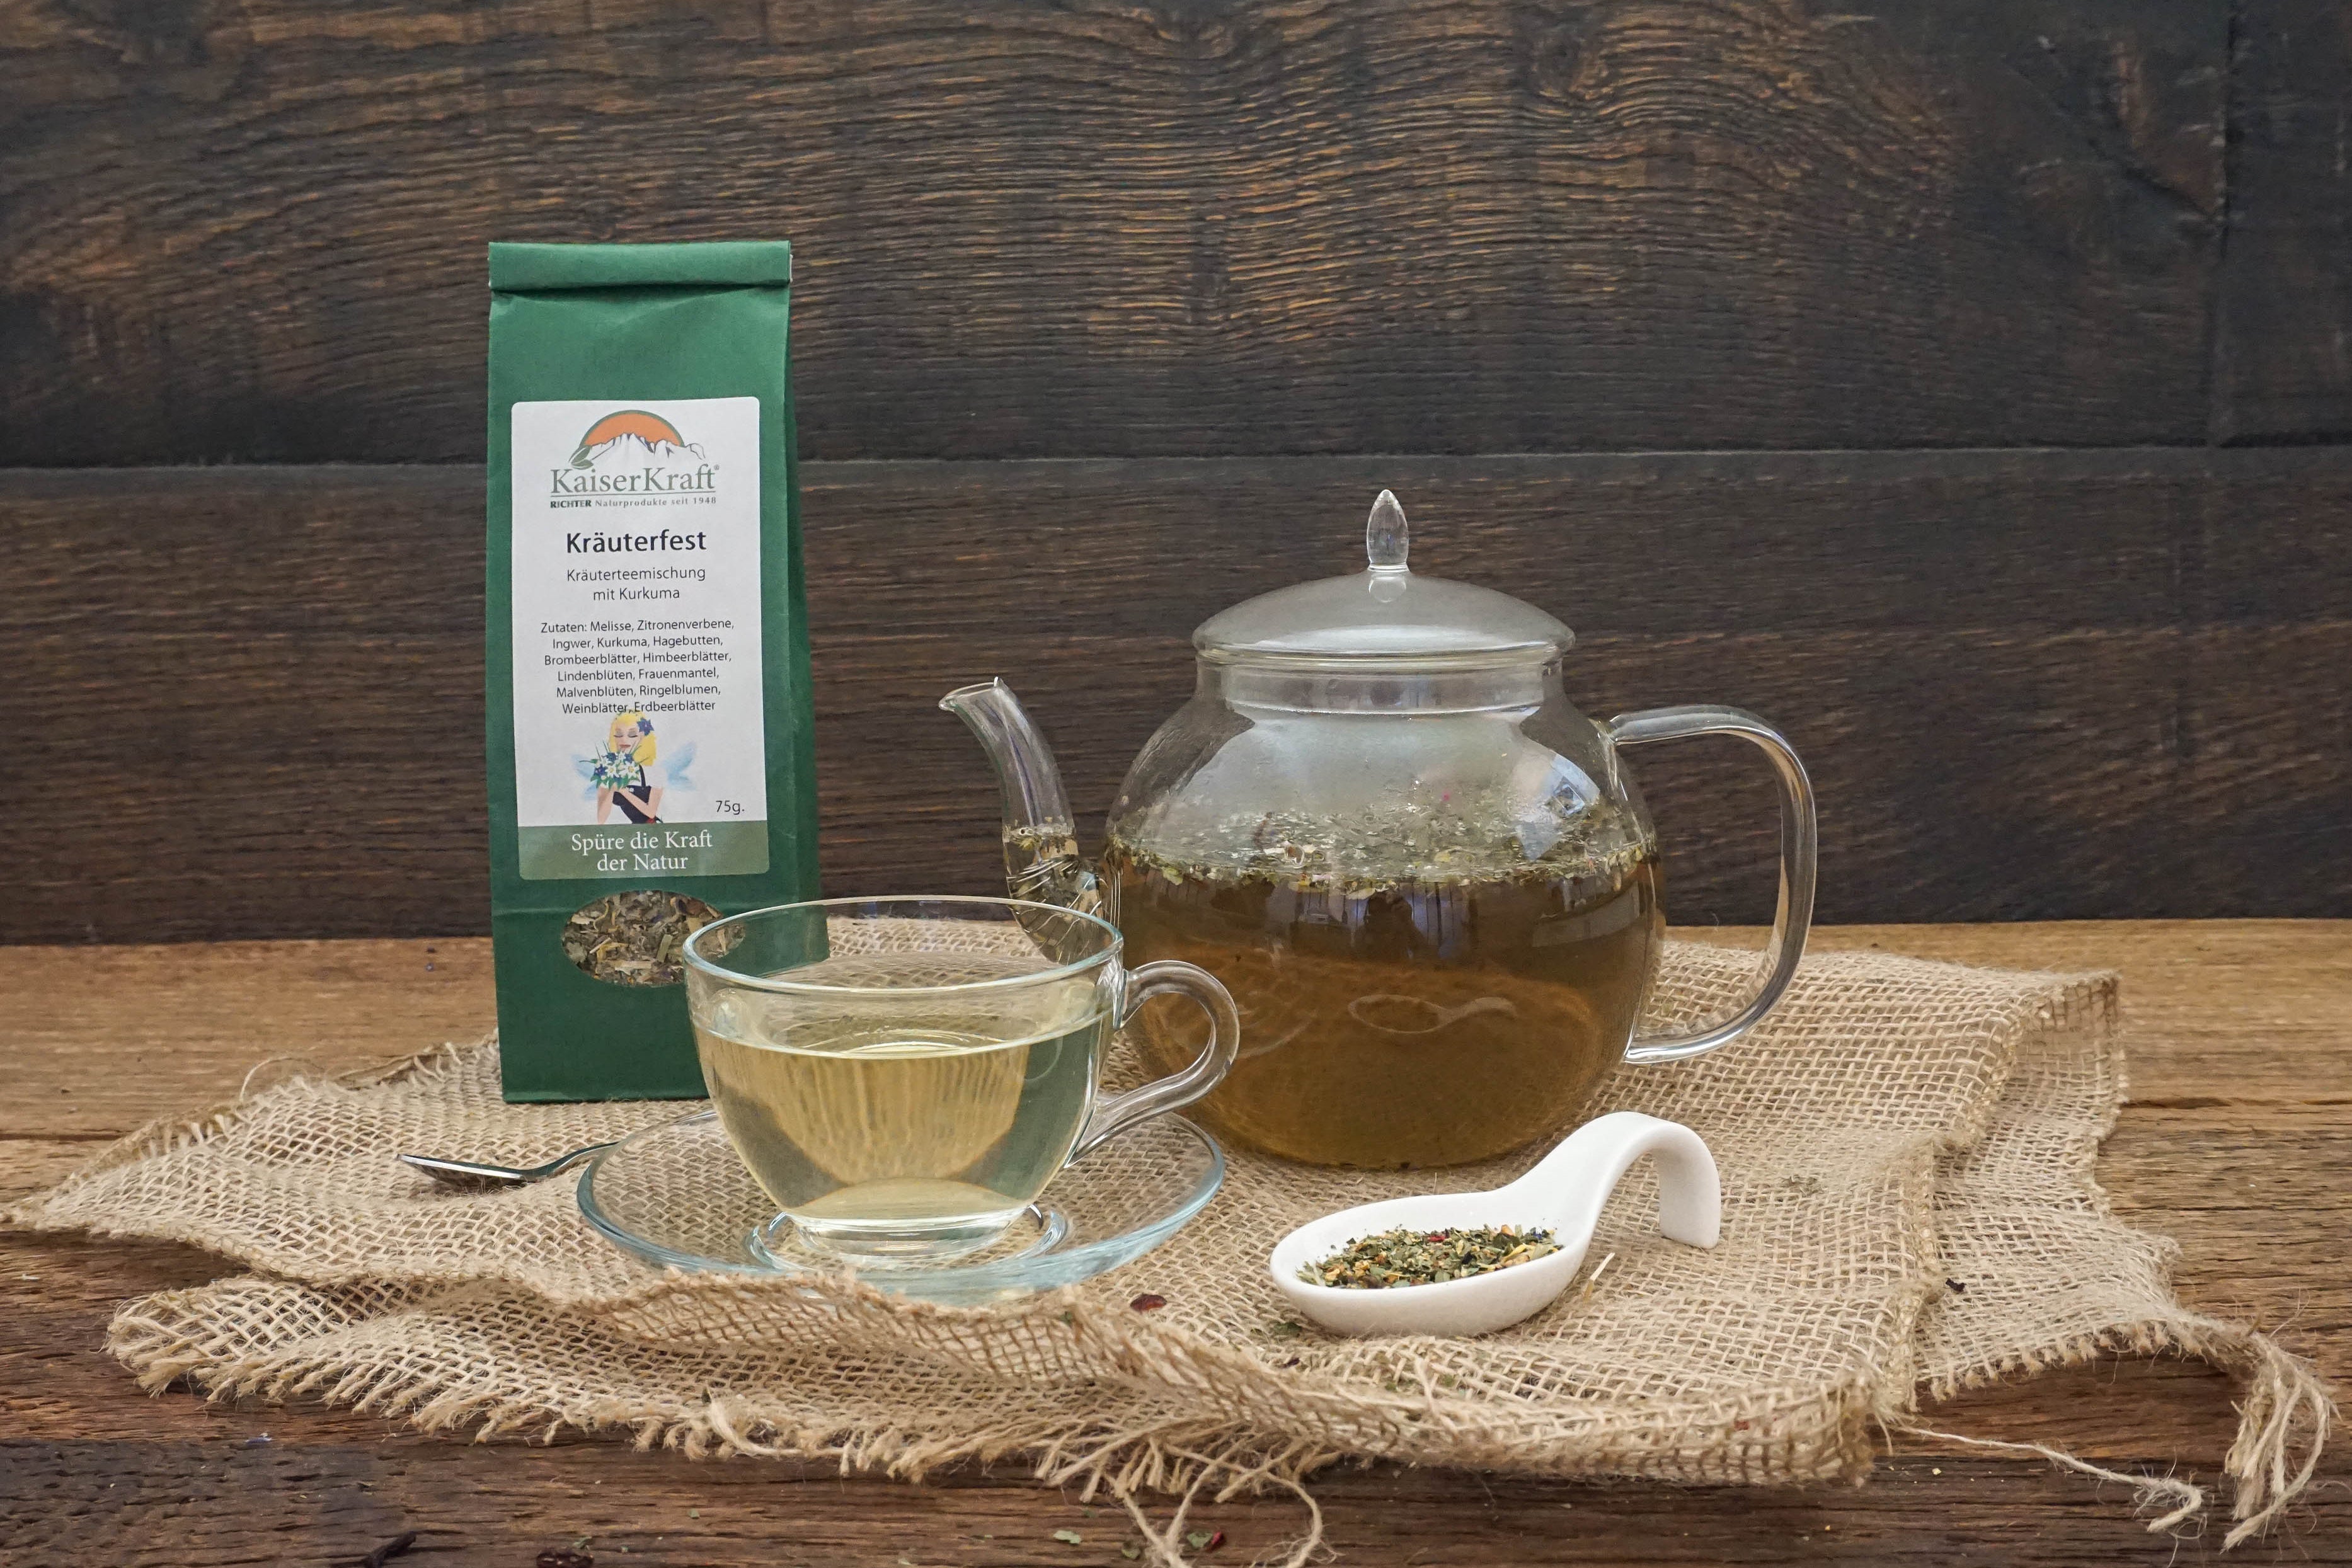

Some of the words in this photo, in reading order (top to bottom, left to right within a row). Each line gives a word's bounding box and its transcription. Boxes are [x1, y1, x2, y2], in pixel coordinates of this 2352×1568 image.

[550, 500, 592, 508] RICHTER
[595, 498, 667, 509] Naturprodukte
[670, 497, 689, 505] seit
[693, 496, 716, 505] 1948
[566, 529, 707, 554] Kräuterfest
[566, 566, 706, 582] Kräuterteemischung
[593, 589, 615, 601] mit
[619, 587, 680, 600] Kurkuma
[541, 622, 587, 633] Zutaten:
[590, 621, 634, 632] Melisse,
[637, 619, 734, 631] Zitronenverbene,
[553, 638, 594, 650] Ingwer,
[597, 638, 650, 649] Kurkuma,
[653, 636, 723, 648] Hagebutten,
[544, 653, 640, 666] Brombeerblätter,
[643, 651, 732, 663] Himbeerblätter,
[558, 670, 635, 682] Lindenblüten,
[639, 667, 719, 680] Frauenmantel,
[556, 686, 636, 698] Malvenblüten,
[640, 685, 721, 697] Ringelblumen,
[634, 701, 716, 712] Erdbeerblätter
[715, 800, 745, 815] 75g.
[571, 833, 624, 856] Spüre
[630, 832, 660, 849] die
[664, 830, 713, 849] Kraft
[597, 856, 627, 871] der
[634, 854, 688, 870] Natur
